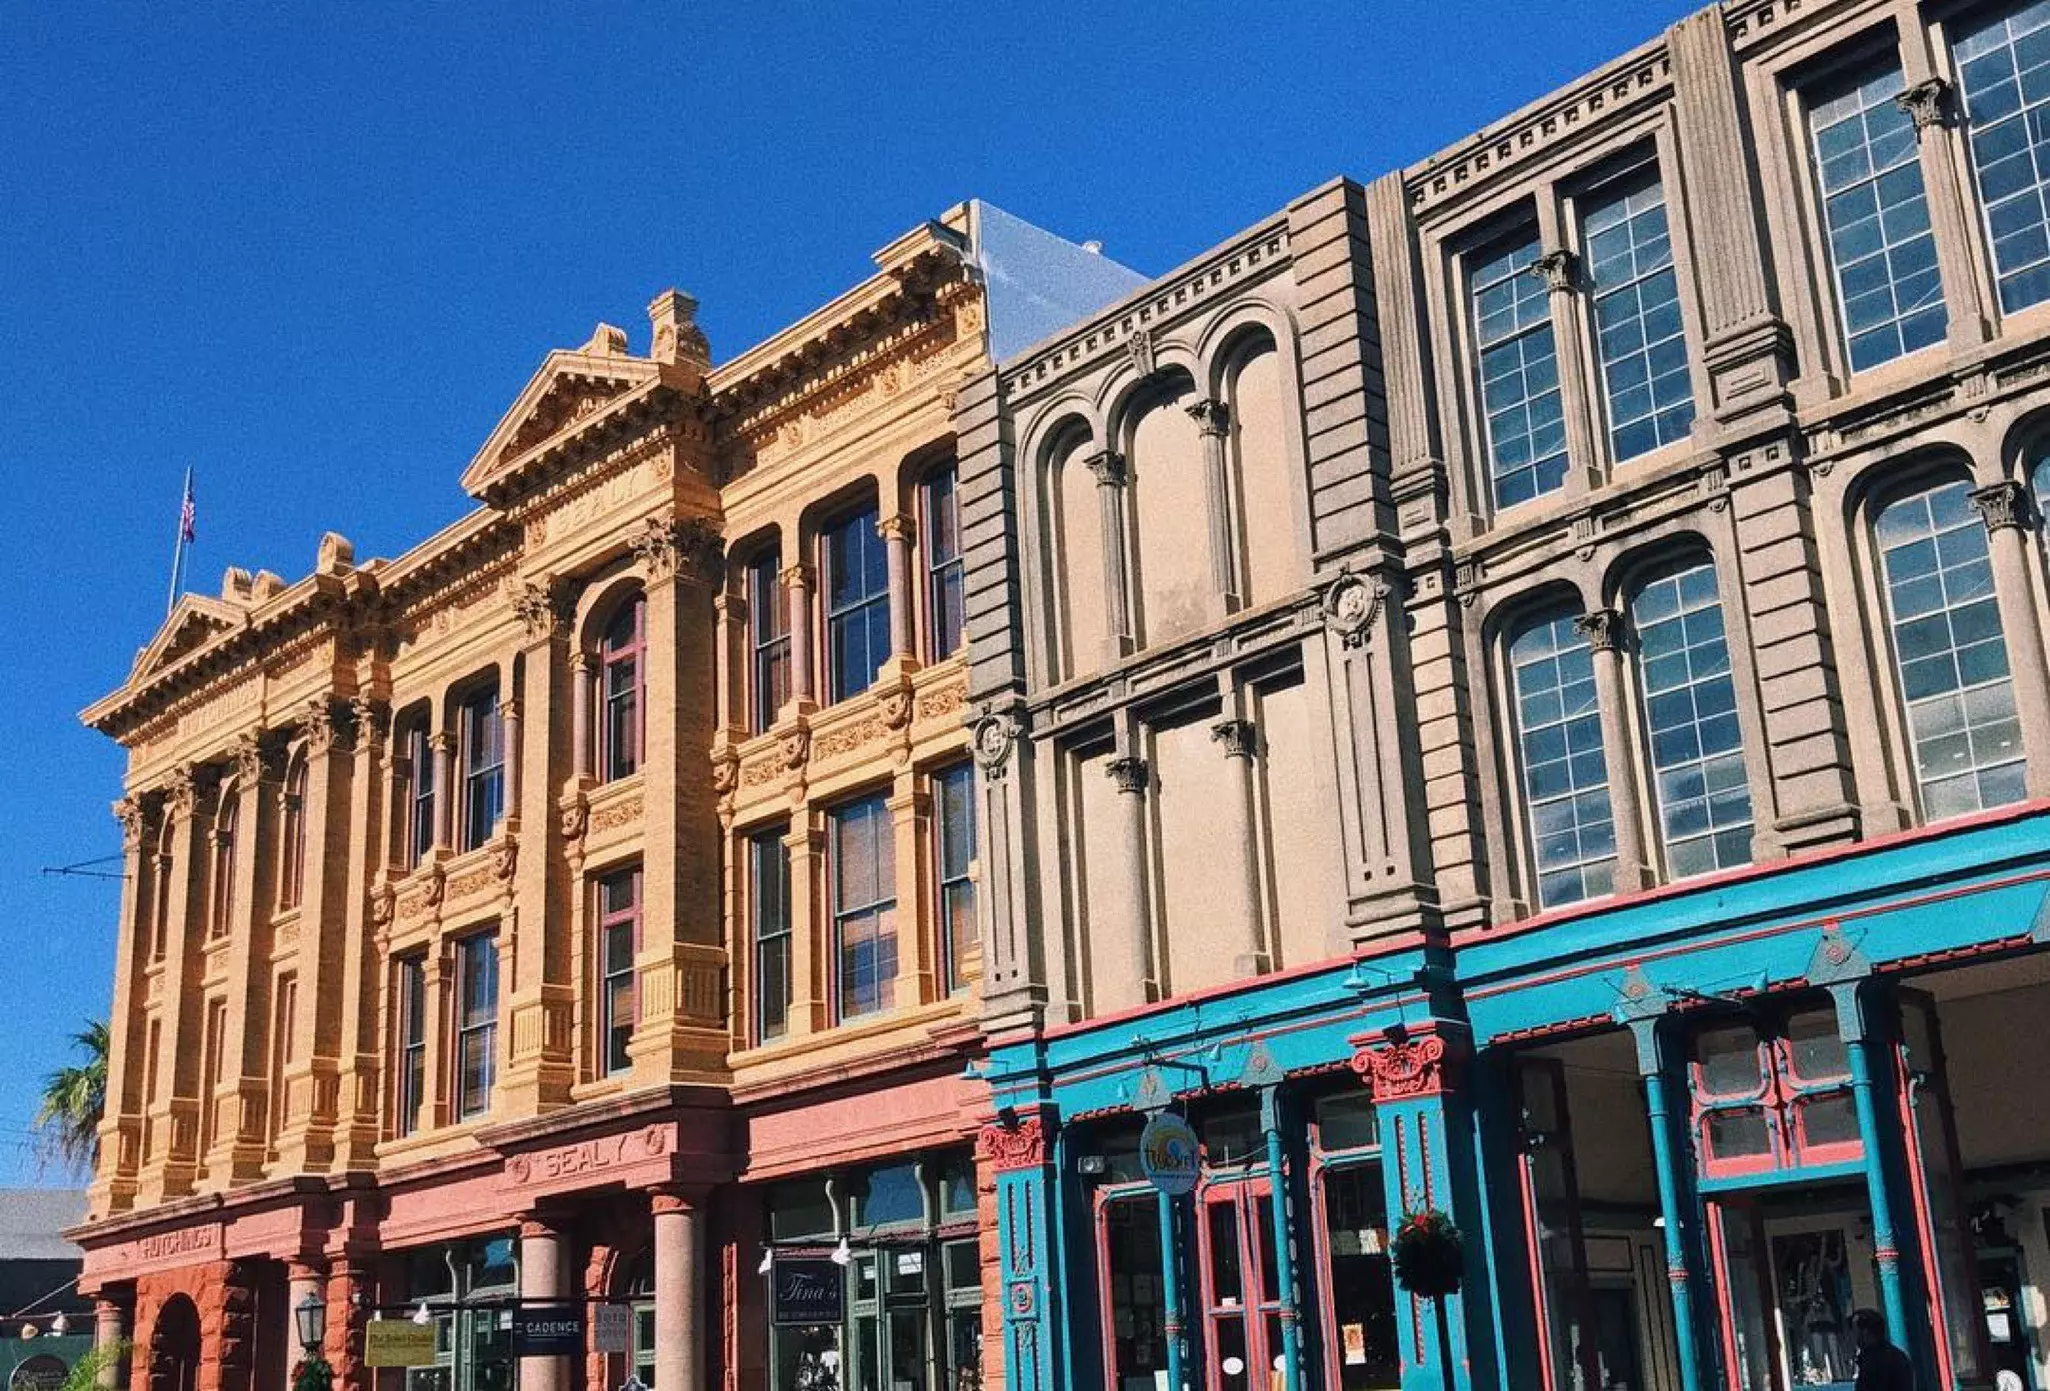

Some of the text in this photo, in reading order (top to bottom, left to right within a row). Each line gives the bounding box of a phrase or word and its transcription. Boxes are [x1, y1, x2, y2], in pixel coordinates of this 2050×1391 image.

[546, 1134, 628, 1177] SEALY
[142, 1226, 213, 1258] HUTCHINGS
[780, 1273, 837, 1301] Tina's
[527, 1320, 580, 1333] CADENCE
